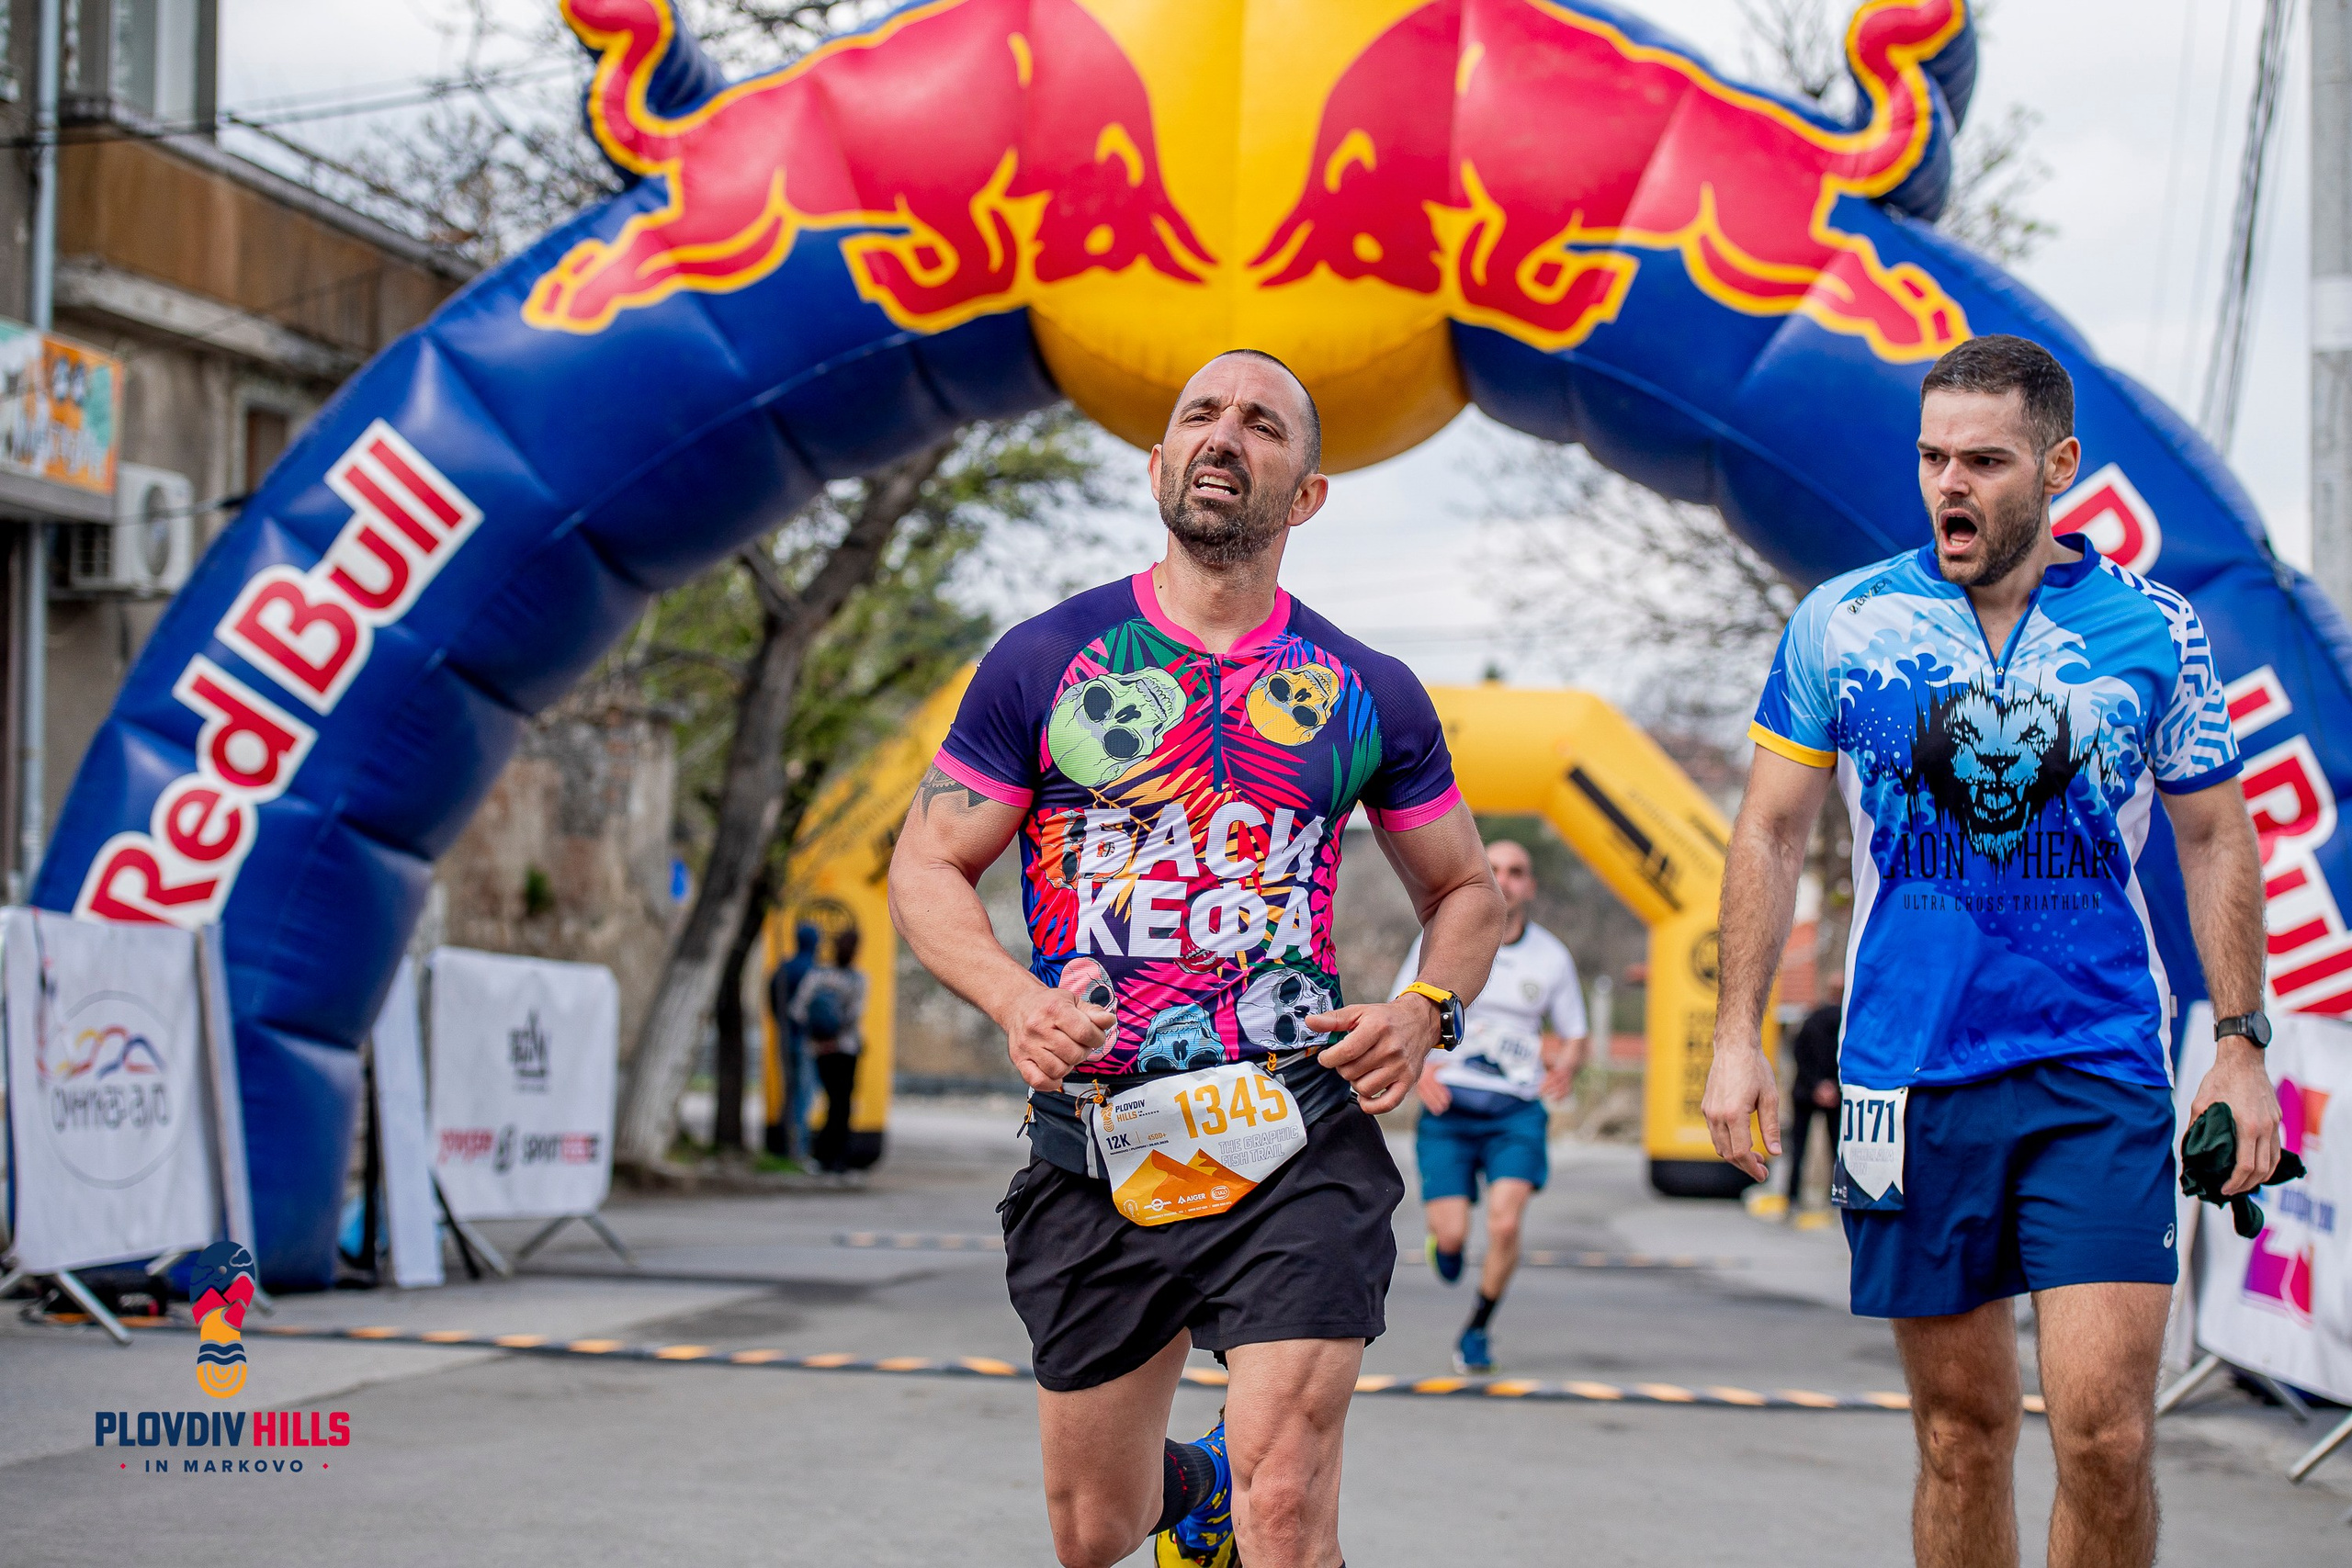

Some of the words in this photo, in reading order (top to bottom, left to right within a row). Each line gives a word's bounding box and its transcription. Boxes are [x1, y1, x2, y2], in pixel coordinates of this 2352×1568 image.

[81, 661, 309, 921] Red
[222, 426, 474, 707] Bull
[1904, 894, 1946, 910] ULTRA
[1954, 895, 2005, 911] CROSS
[2012, 893, 2100, 911] TRIATHLON
[1076, 879, 1313, 960] КЕФА
[1114, 1099, 1146, 1113] PLOVDIV
[1116, 1111, 1137, 1122] HILLS
[1173, 1073, 1289, 1140] 1345
[1105, 1133, 1132, 1150] 12K
[1218, 1138, 1242, 1155] THE
[1243, 1125, 1299, 1150] GRAPHIC
[1220, 1151, 1250, 1168] FISH
[1249, 1143, 1285, 1163] TRAIL
